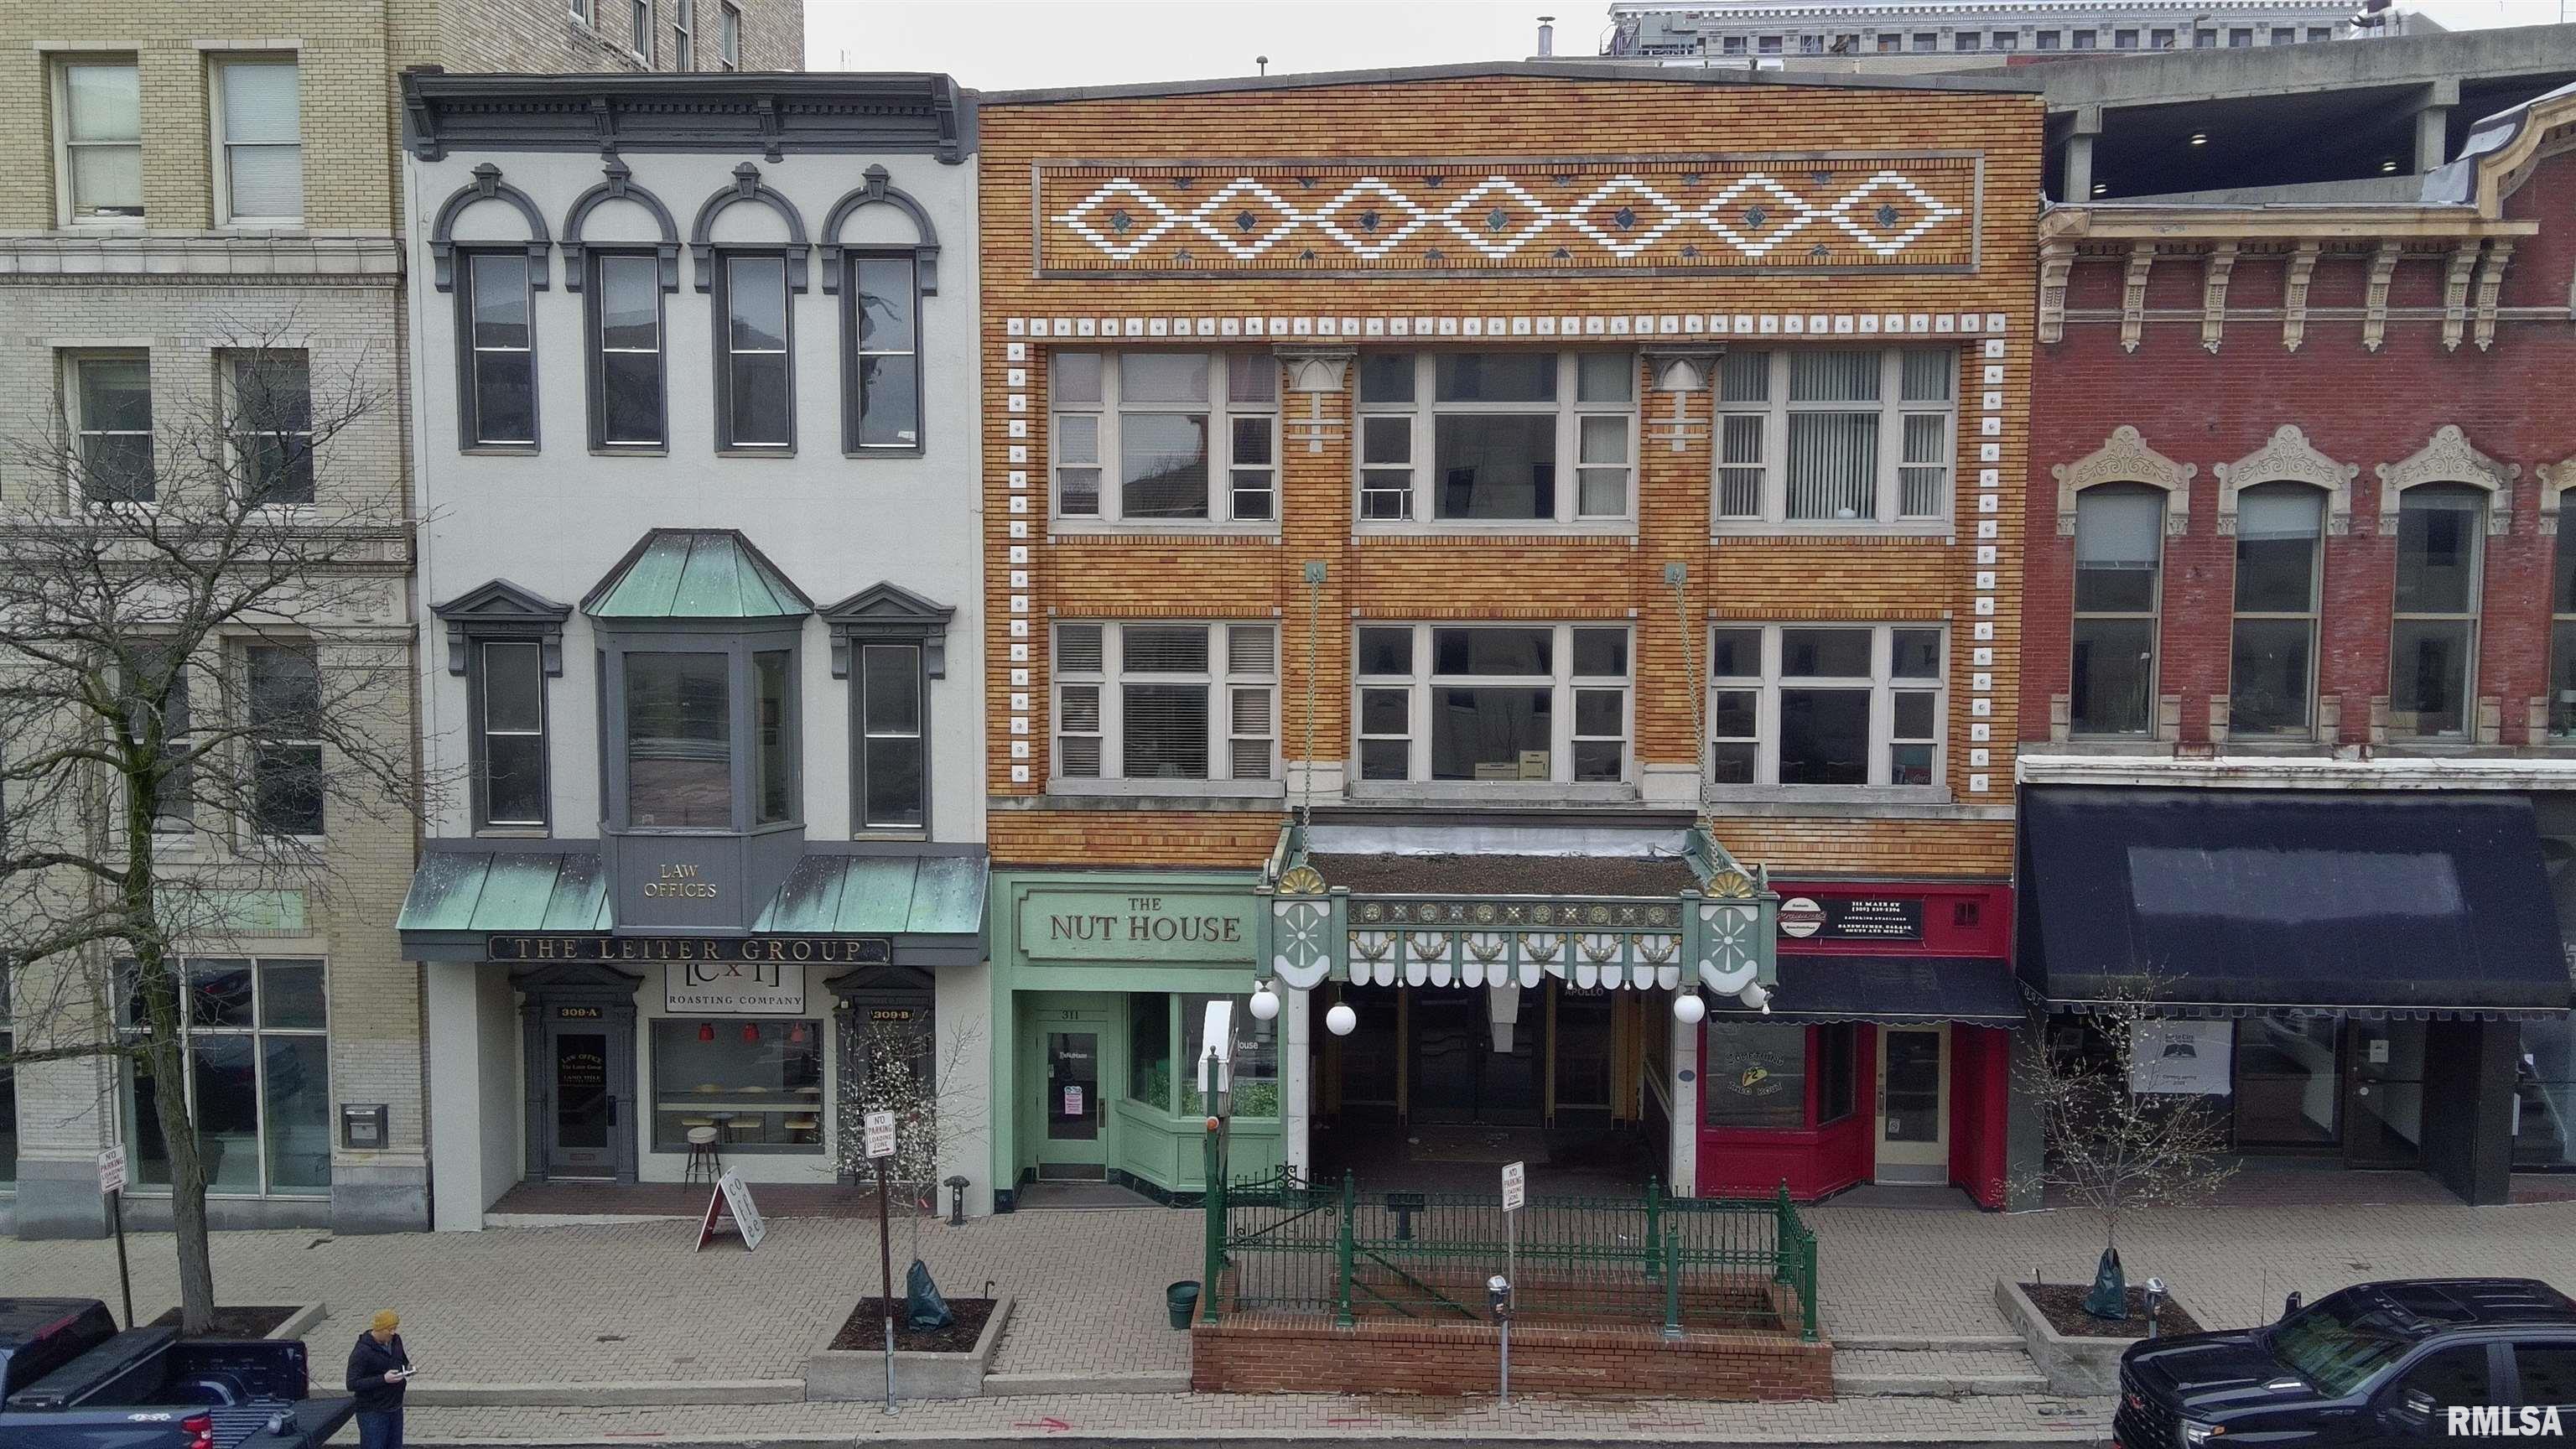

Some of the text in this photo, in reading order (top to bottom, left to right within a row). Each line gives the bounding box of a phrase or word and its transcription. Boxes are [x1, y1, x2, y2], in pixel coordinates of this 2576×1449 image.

[661, 864, 698, 880] LAW
[644, 883, 717, 898] OFFICES
[1128, 897, 1161, 911] THE
[1050, 916, 1241, 942] NUT HOUSE
[514, 938, 861, 961] THE LEITER GROUP
[1564, 987, 1604, 997] APOLLO
[669, 995, 802, 1005] ROASTING COMPANY
[1062, 1010, 1079, 1020] 311
[874, 1115, 885, 1124] NO
[869, 1124, 892, 1135] PARKING
[869, 1133, 892, 1144] LOADING
[106, 1150, 116, 1161] NO
[100, 1157, 124, 1173] PARKING
[1509, 1167, 1517, 1177] NO
